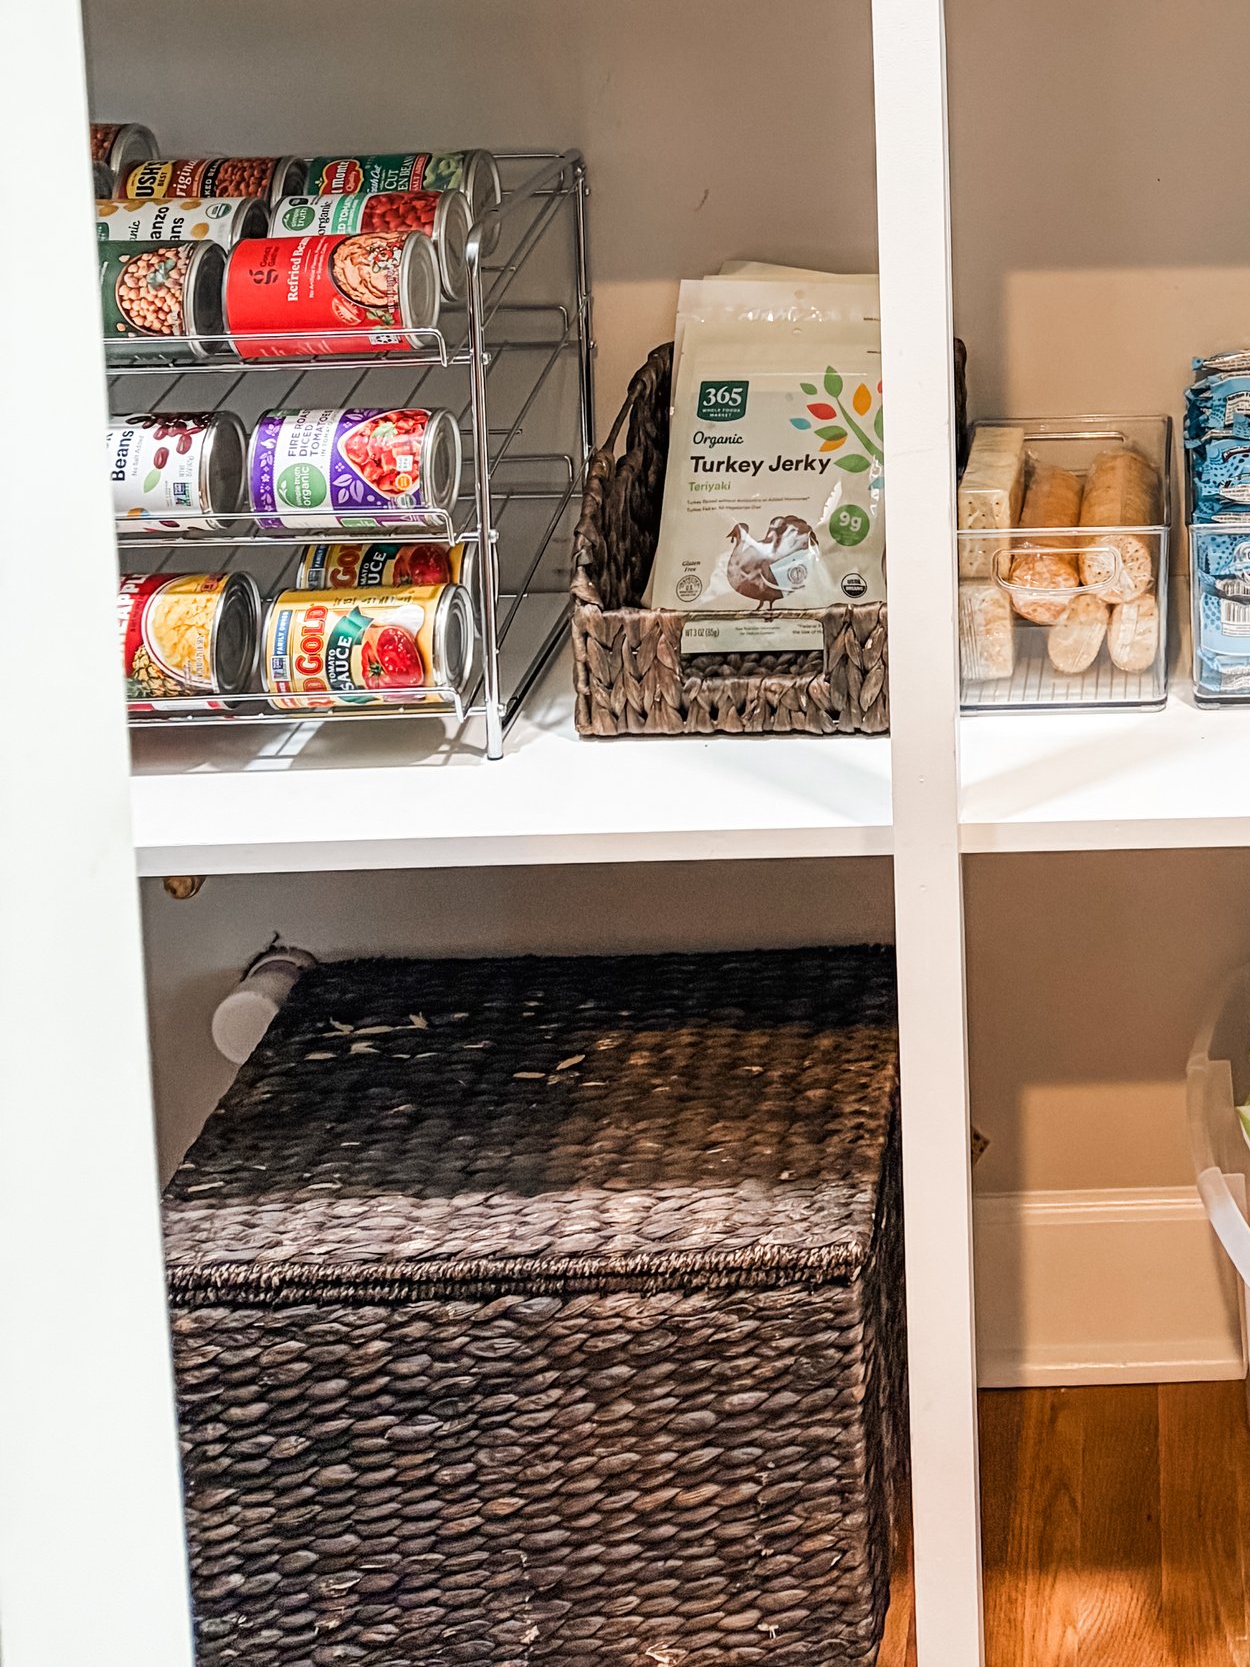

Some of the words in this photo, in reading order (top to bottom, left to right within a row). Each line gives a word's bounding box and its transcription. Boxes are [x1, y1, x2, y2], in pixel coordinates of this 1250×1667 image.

[135, 159, 169, 197] USH'S
[157, 171, 168, 187] BEST
[331, 160, 350, 189] Monte
[385, 169, 399, 190] CUT
[318, 199, 333, 235] organic
[288, 256, 301, 302] Refried
[703, 386, 744, 407] 365
[287, 432, 299, 458] FIRE
[298, 424, 314, 458] DICED
[692, 430, 744, 449] Organic
[111, 429, 135, 482] Beans
[690, 454, 765, 477] Turkey
[768, 453, 832, 475] Jerky
[302, 465, 312, 508] organic
[688, 481, 732, 494] Teriyaki
[838, 510, 863, 533] 9g
[295, 605, 328, 677] GOLD
[325, 648, 337, 684] TOMATO
[335, 635, 353, 691] SAUCE
